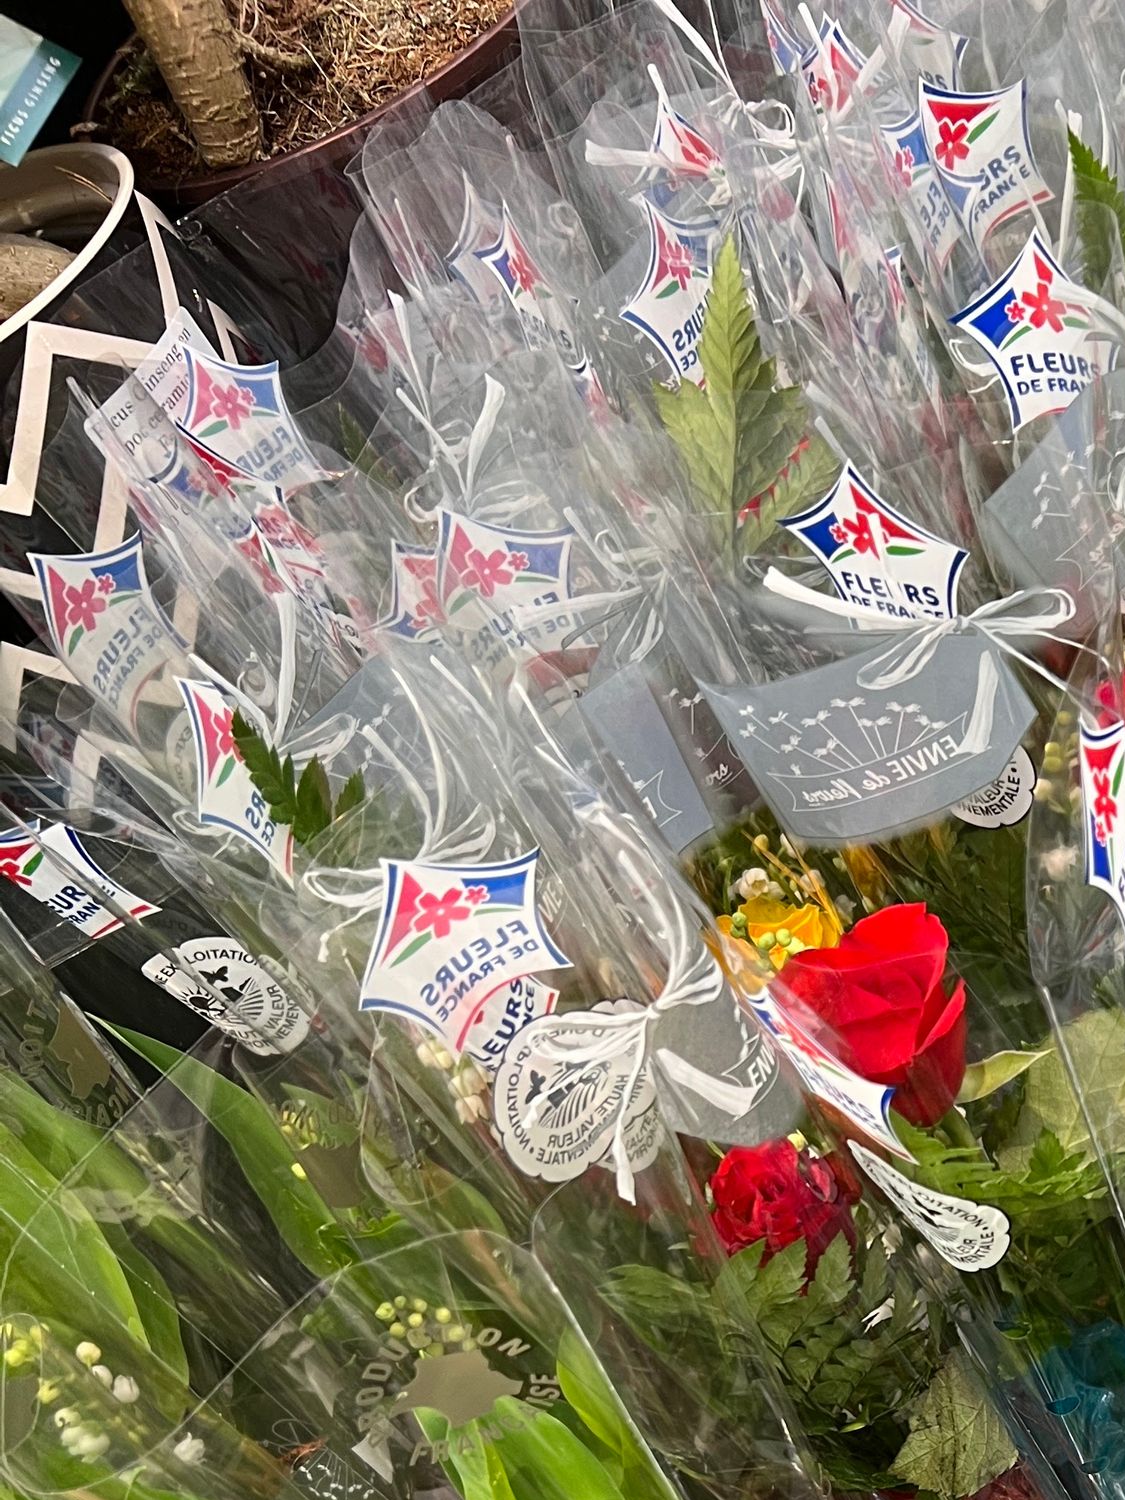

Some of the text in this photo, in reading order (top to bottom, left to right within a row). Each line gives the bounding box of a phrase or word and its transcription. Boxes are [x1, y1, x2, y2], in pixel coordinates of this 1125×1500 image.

[24, 56, 61, 107] GINSENG
[1017, 380, 1041, 396] DE
[841, 571, 940, 607] FLERS
